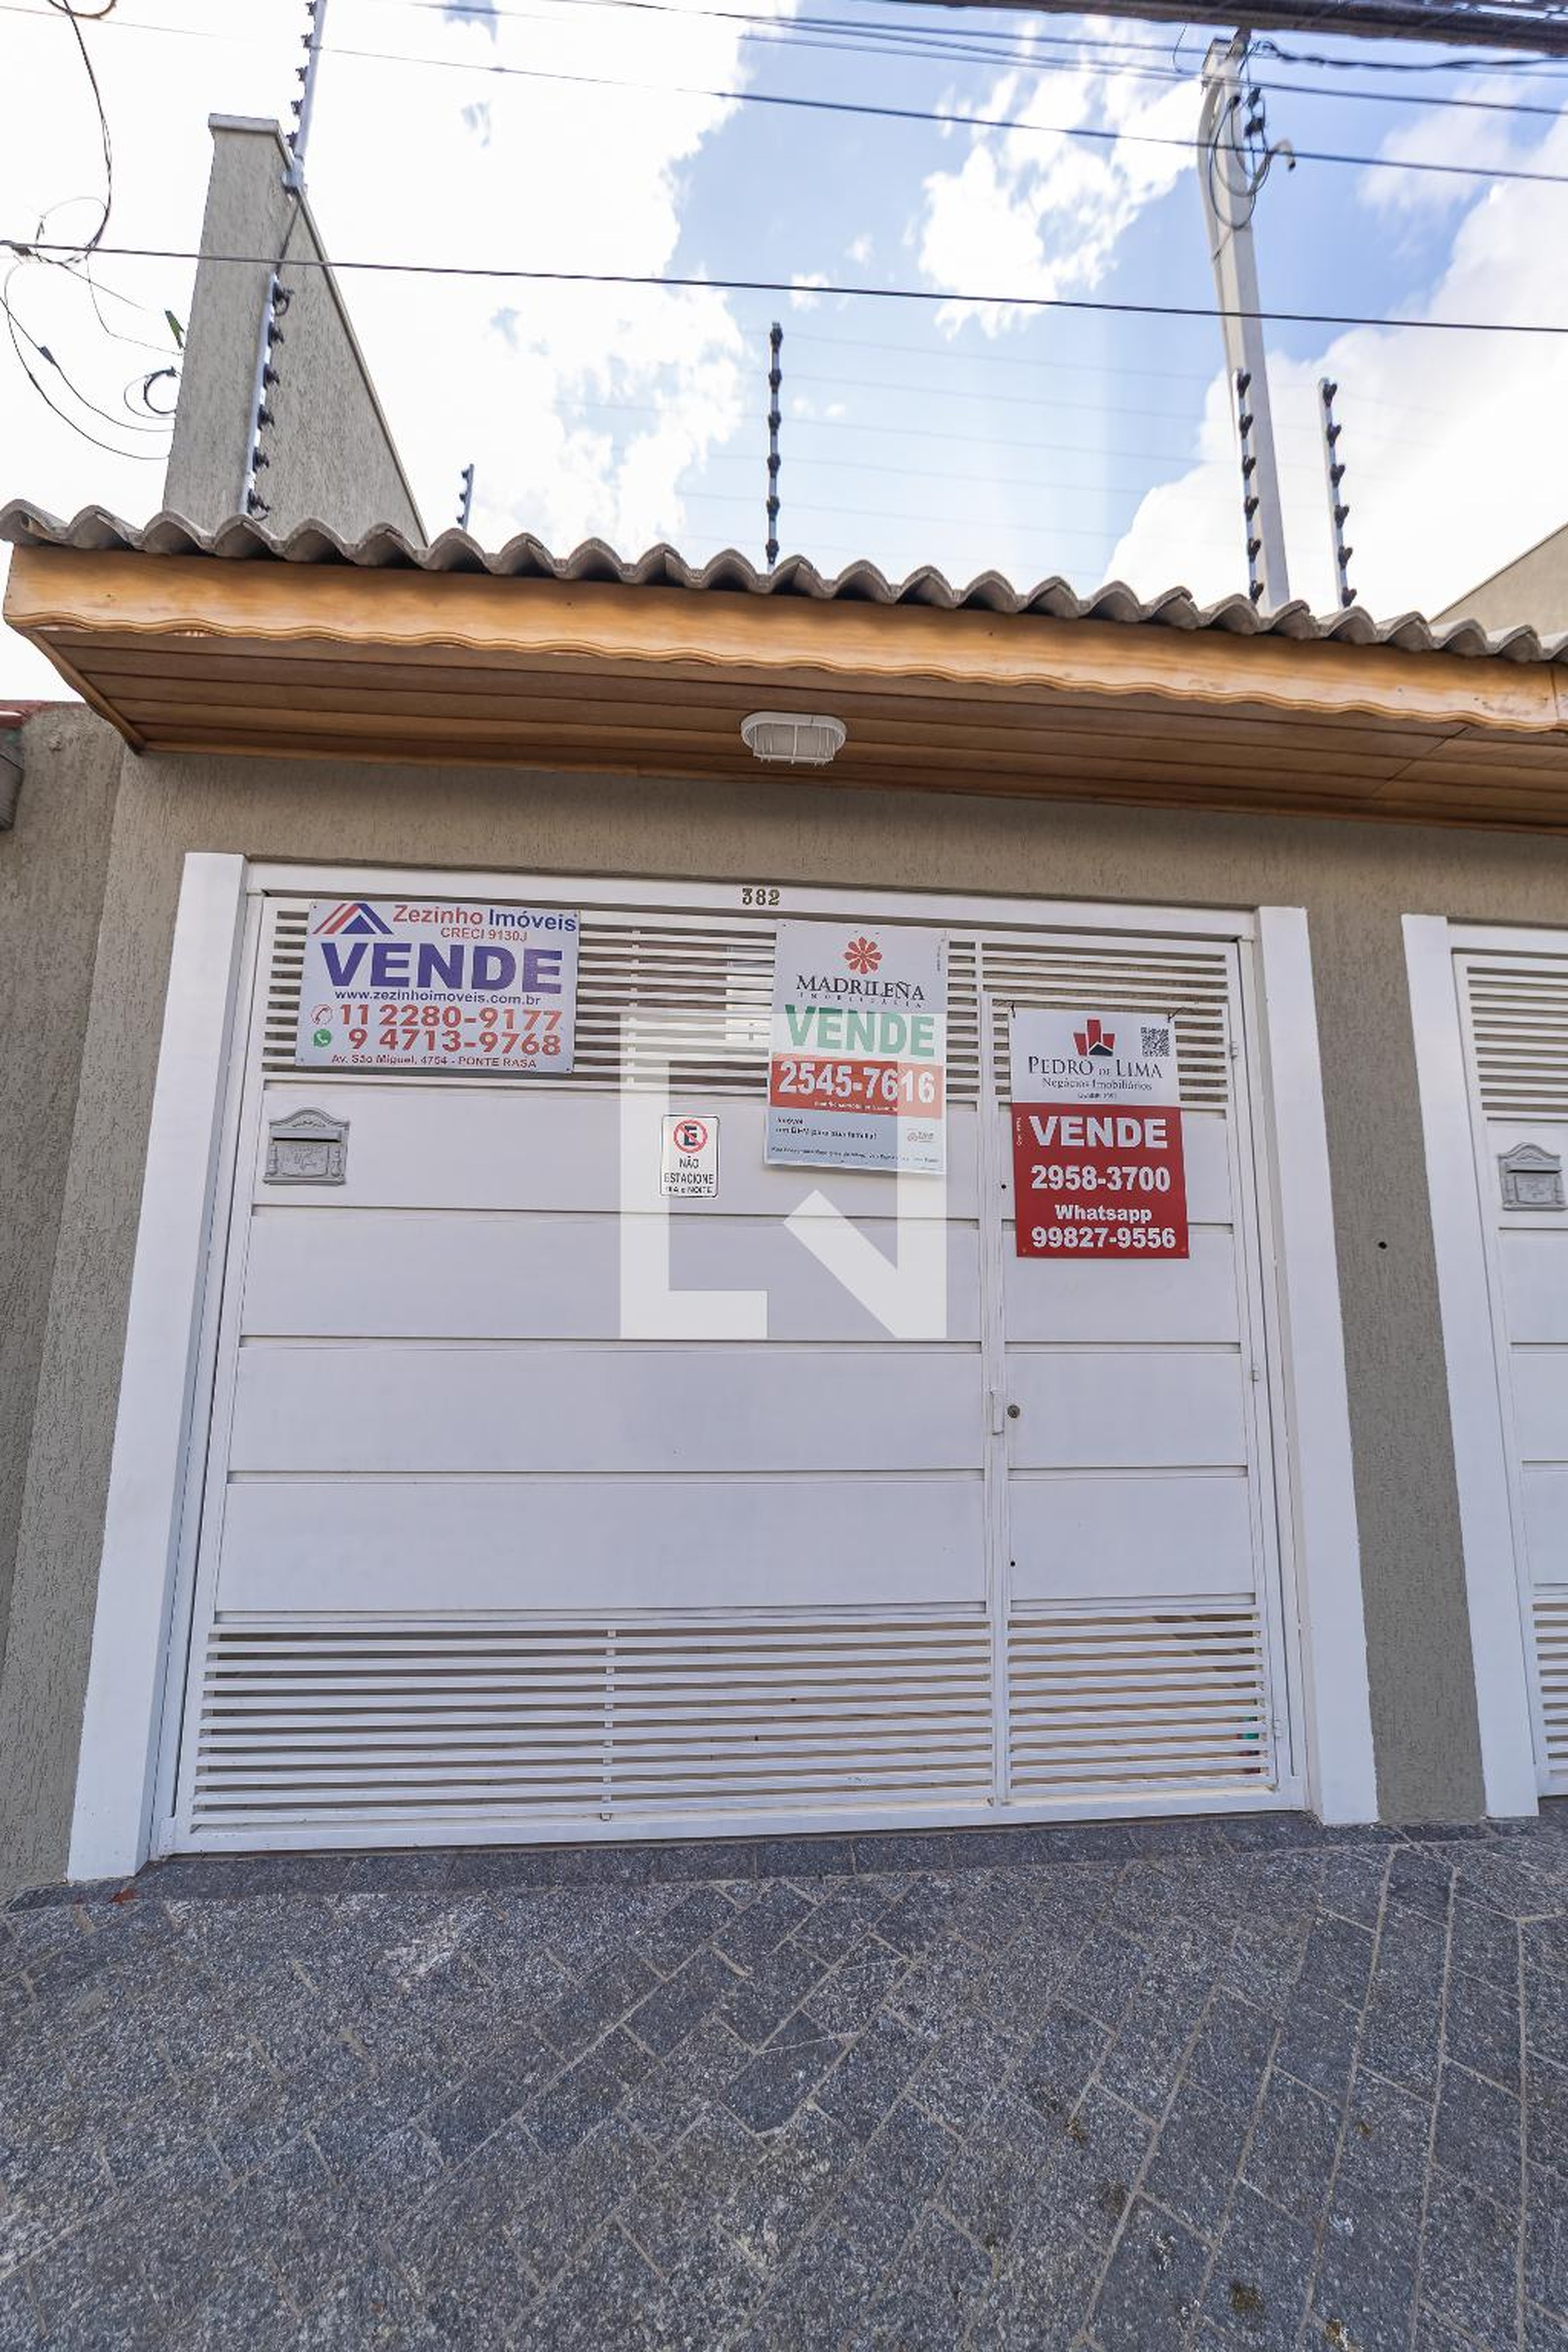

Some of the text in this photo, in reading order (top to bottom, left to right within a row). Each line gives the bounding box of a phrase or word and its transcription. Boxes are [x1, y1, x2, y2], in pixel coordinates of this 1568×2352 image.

[742, 888, 780, 905] 382
[392, 905, 577, 931] Zezinho Imóveis
[441, 927, 485, 939] CRECI
[321, 942, 562, 994] VENDE
[335, 990, 540, 1006] www.zezinhoimoveis.com.br
[796, 975, 924, 1000] MADRILEÑA
[341, 1004, 563, 1031] 11 2280-9177
[348, 1029, 561, 1056] 9 4713-9768
[785, 1004, 935, 1057] VENDE
[1029, 1056, 1093, 1075] PEDRO
[1116, 1059, 1163, 1078] LIMA
[779, 1062, 935, 1103] 2545-7616
[1029, 1116, 1167, 1149] VENDE
[679, 1156, 699, 1169] NÃO
[664, 1173, 714, 1184] ESTACIONE
[1031, 1165, 1171, 1192] 2958-3700
[1055, 1205, 1152, 1223] Whatsapp
[1031, 1226, 1177, 1249] 99827-9556
